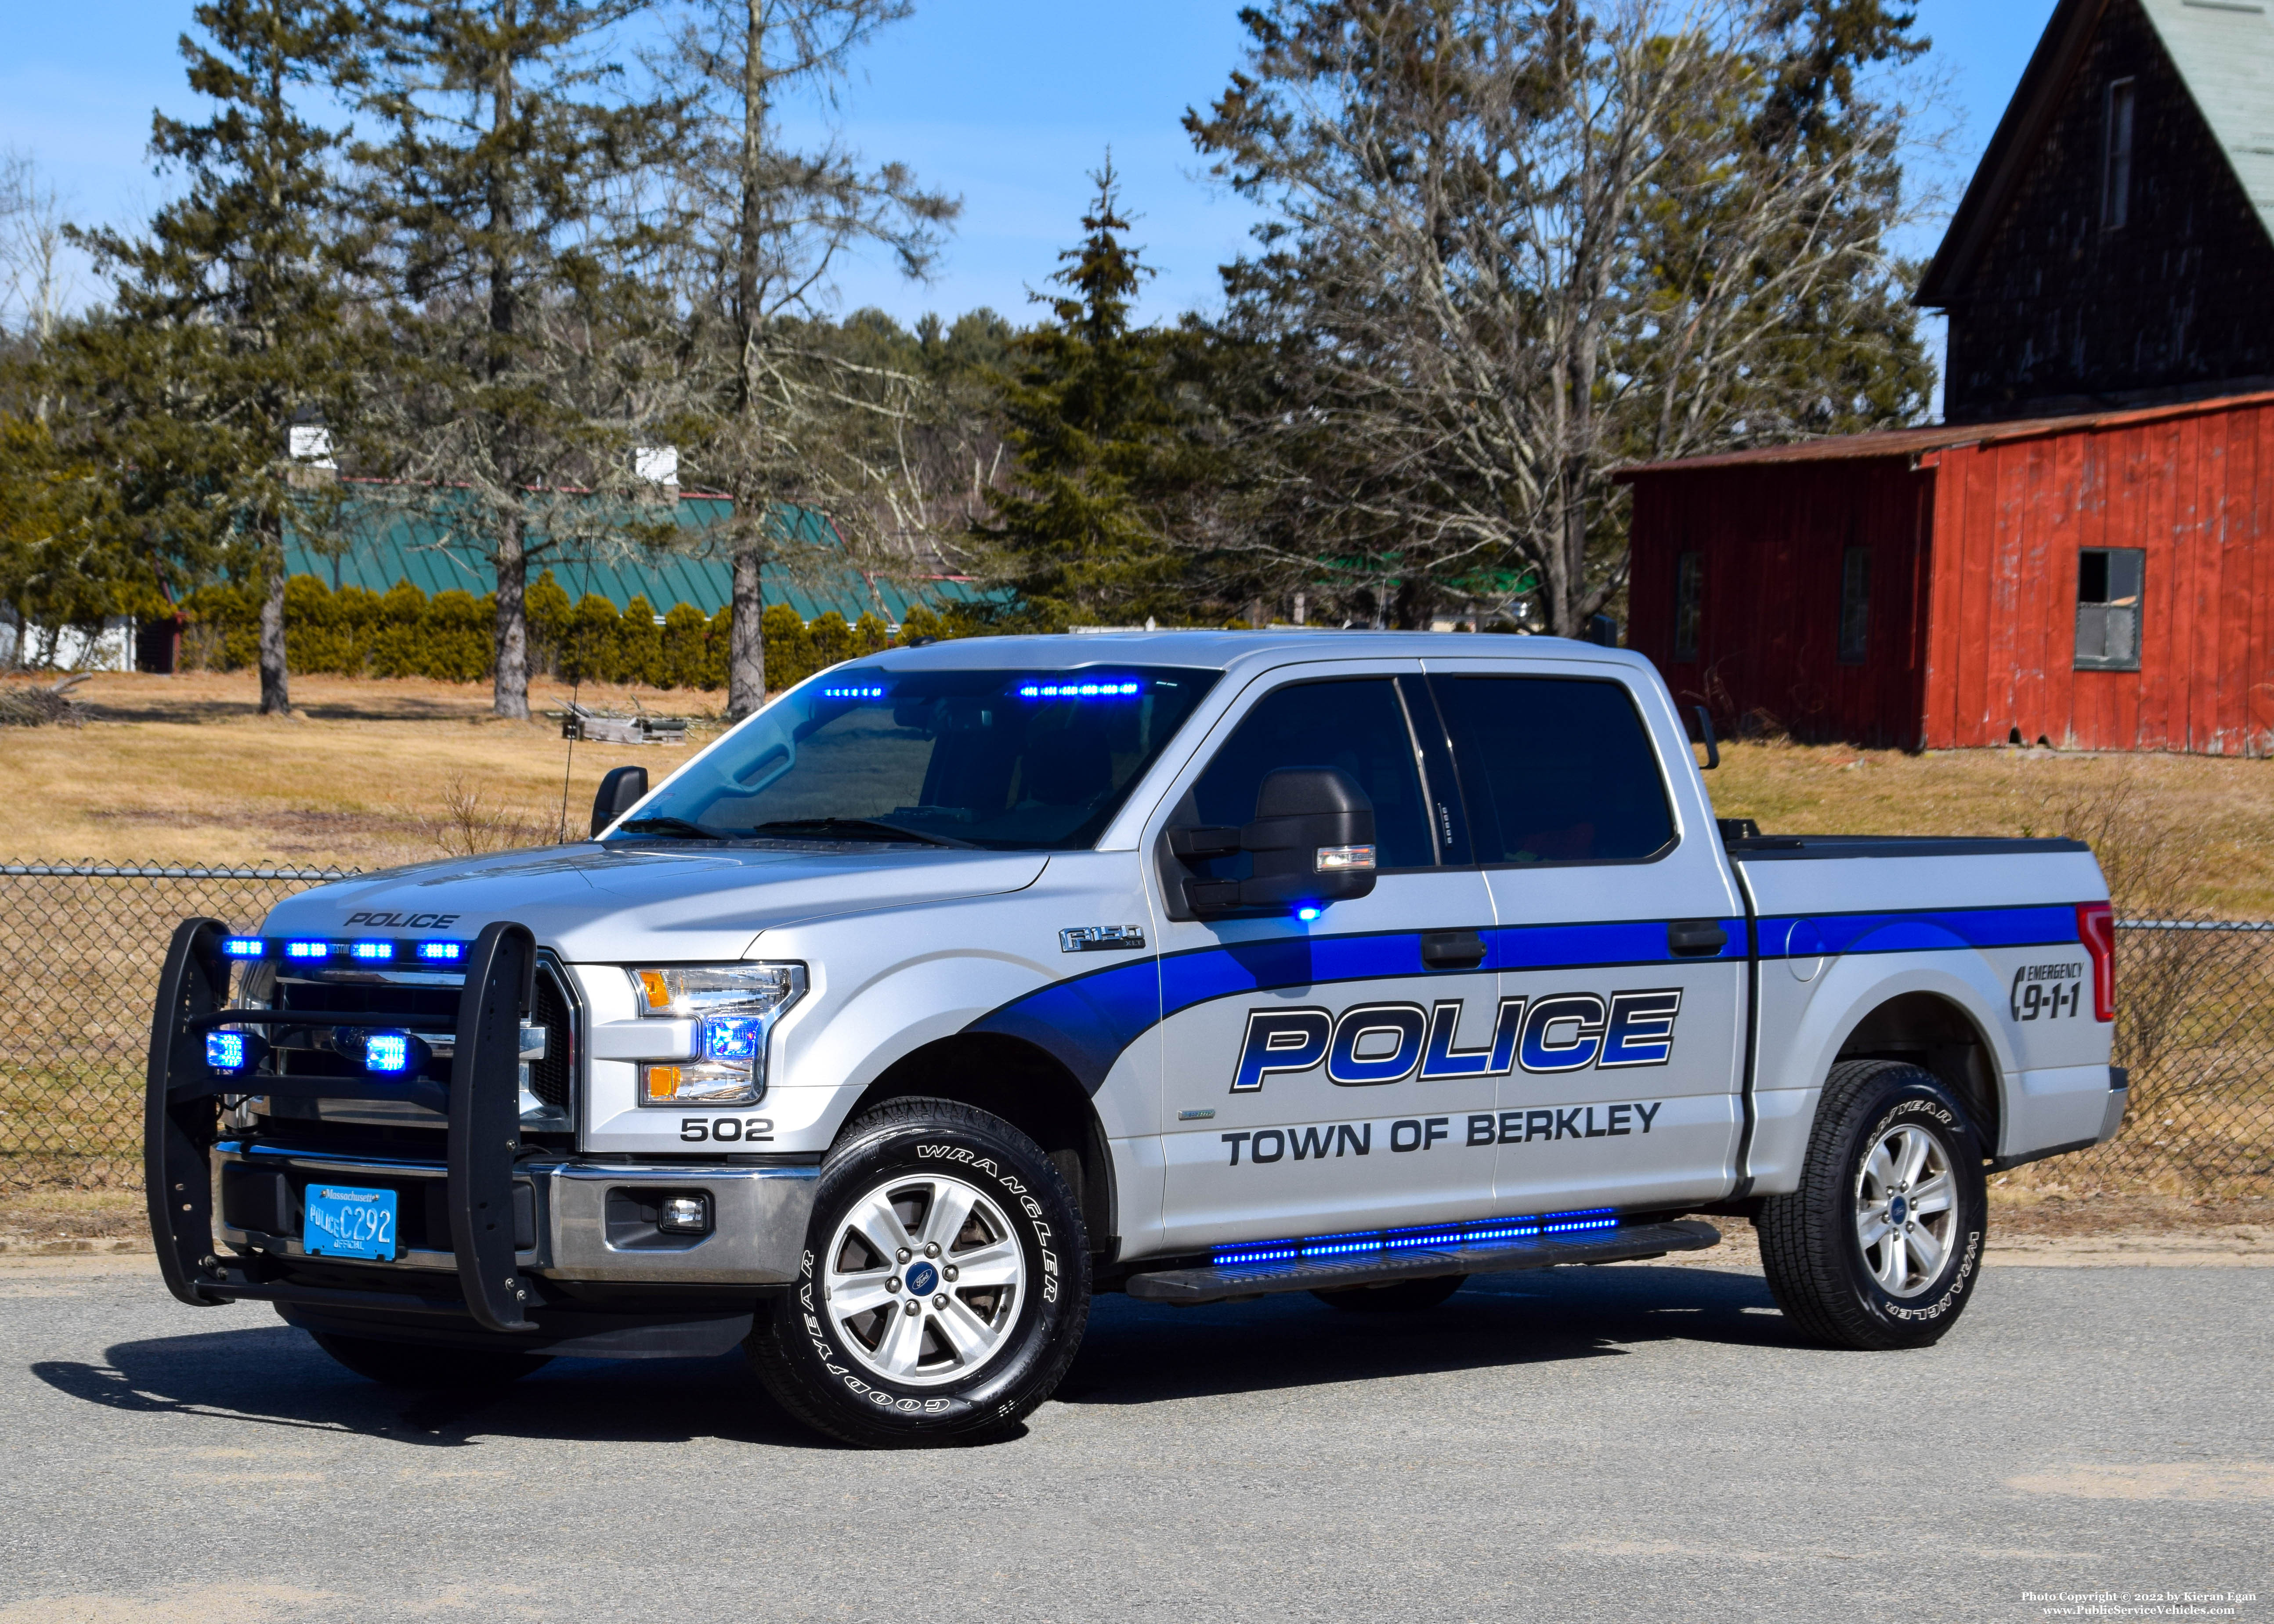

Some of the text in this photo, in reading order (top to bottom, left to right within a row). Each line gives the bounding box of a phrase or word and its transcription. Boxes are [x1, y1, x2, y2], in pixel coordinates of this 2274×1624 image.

[343, 912, 461, 929] POLICE
[2028, 962, 2084, 981] EMERGENCY
[2022, 981, 2081, 1021] 9-1-1
[1229, 986, 1684, 1094] POLICE
[680, 1118, 774, 1142] 502
[1222, 1102, 1662, 1166] TOWN OF BERKLEY
[310, 1204, 390, 1243] POLICE C292
[917, 1145, 1058, 1303] WRANGLER
[334, 1240, 364, 1251] OFFICIAL
[916, 1272, 929, 1287] Ford
[1885, 1232, 1979, 1320] WRANGLER
[800, 1250, 950, 1412] GOODYEAR
